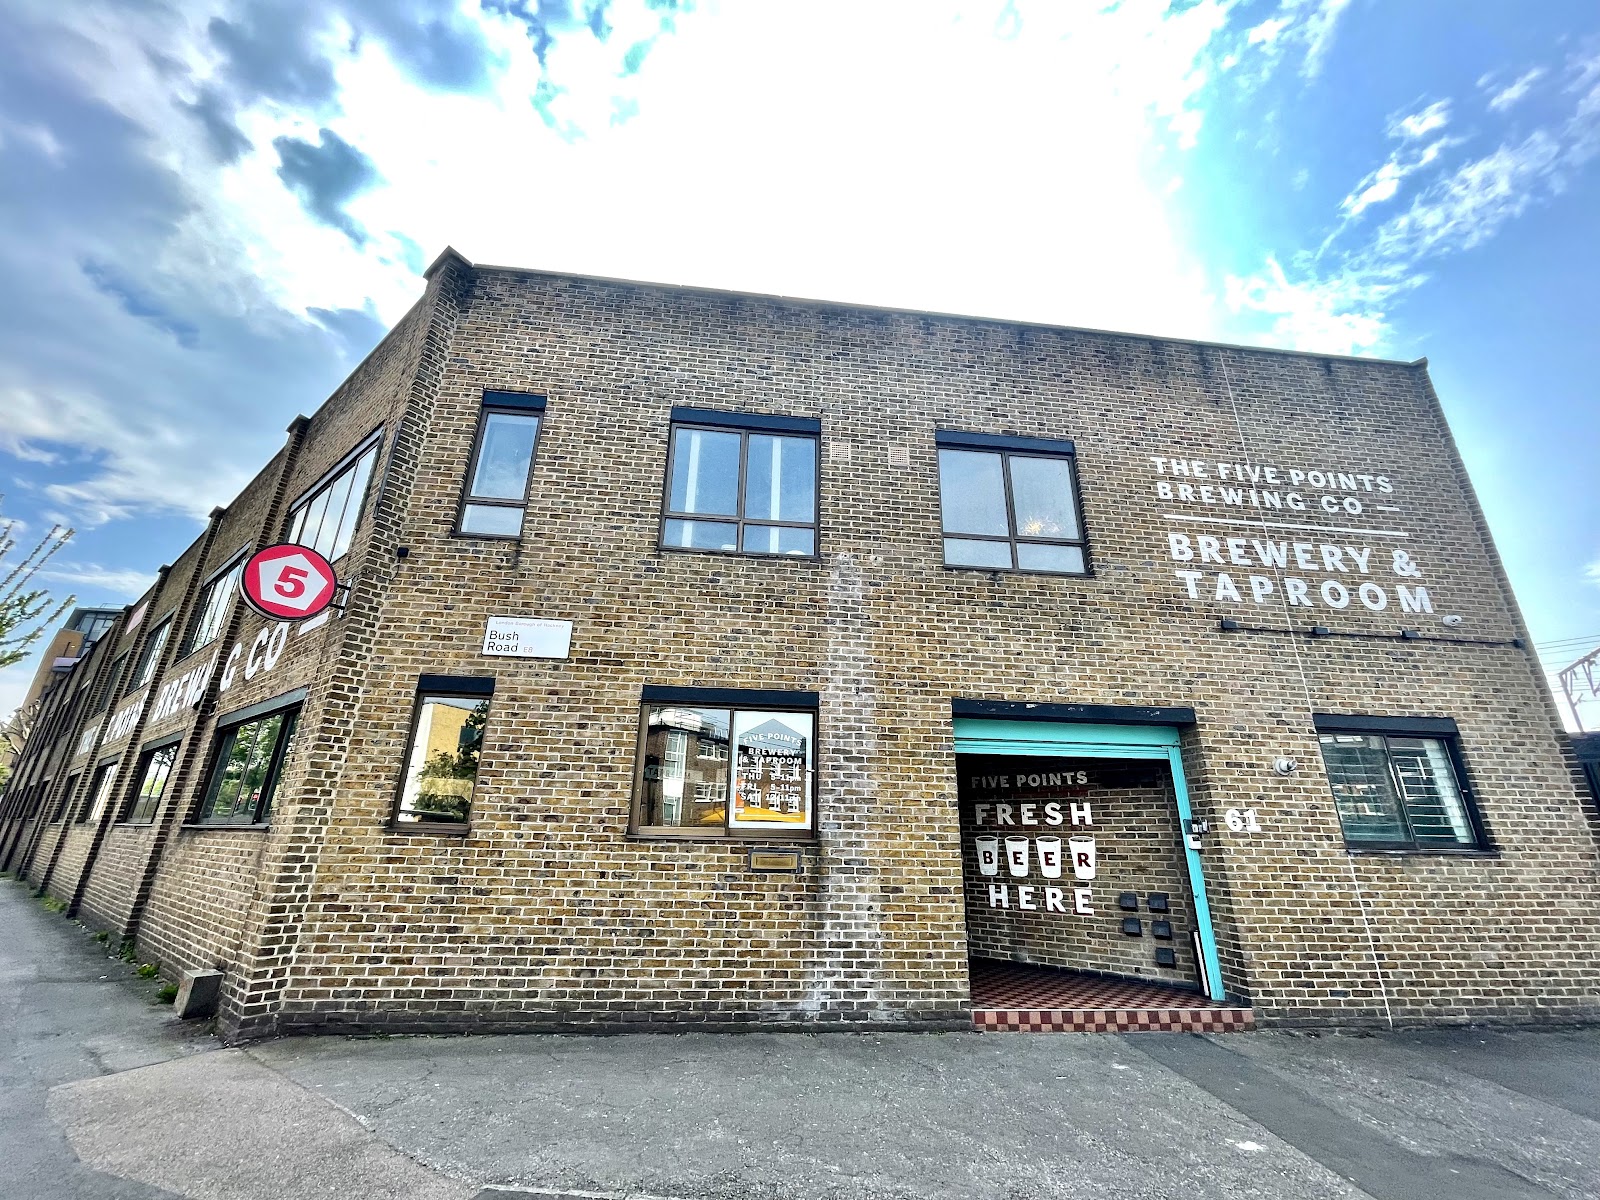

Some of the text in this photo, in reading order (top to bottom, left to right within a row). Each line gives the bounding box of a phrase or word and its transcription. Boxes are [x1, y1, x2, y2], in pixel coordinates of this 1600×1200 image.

[1150, 457, 1393, 493] THE FIVE POINTS
[1157, 482, 1363, 514] BREWING CO
[1168, 533, 1421, 577] BREWERY &
[274, 565, 309, 599] 5
[1175, 570, 1433, 613] TAPROOM
[487, 641, 518, 652] Road
[489, 630, 519, 640] Bush
[743, 733, 802, 746] FIVE POINTS
[749, 748, 796, 756] BREWERY
[753, 756, 802, 764] TAPROOM
[971, 770, 1088, 788] FIVE POINTS
[975, 802, 1093, 826] FRESH
[1225, 809, 1261, 832] 61
[983, 850, 1092, 867] BEER
[989, 884, 1095, 915] HERE
